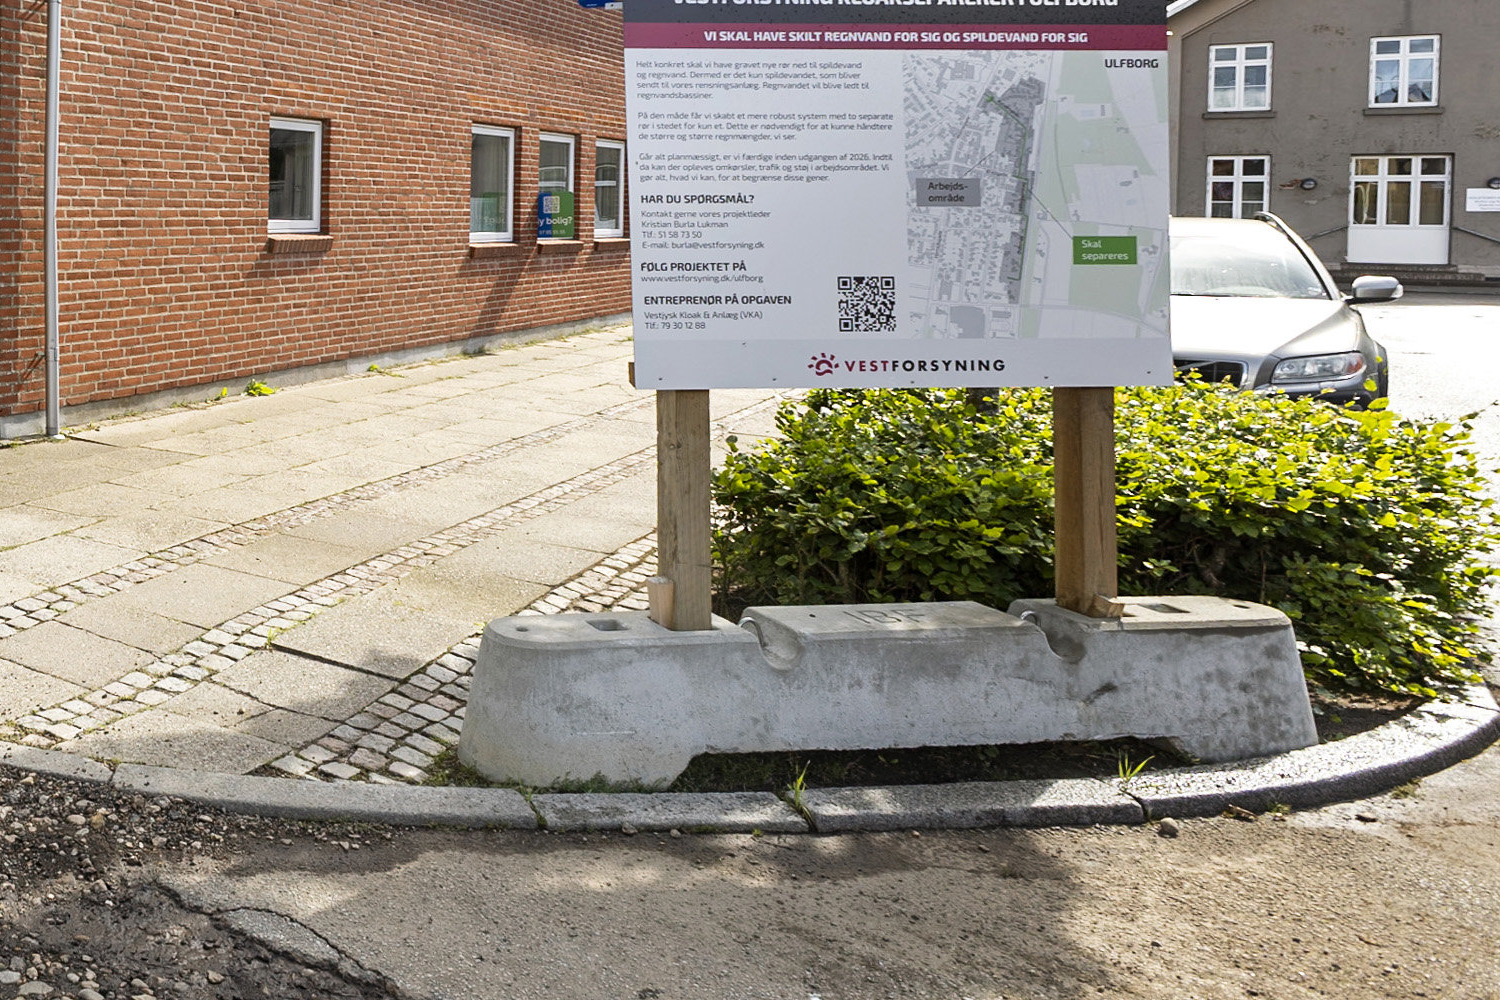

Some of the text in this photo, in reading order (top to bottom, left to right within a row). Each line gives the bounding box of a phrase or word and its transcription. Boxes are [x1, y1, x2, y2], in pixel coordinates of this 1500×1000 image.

[704, 31, 1088, 43] VI SKAL HAVE SKILT REGNVAND FOR SIG OG SPILDEVAND FOR SIG
[734, 62, 761, 70] gravet
[809, 61, 818, 69] til
[818, 62, 862, 70] spildevand
[1104, 58, 1159, 69] ULFBORG
[636, 72, 647, 80] og
[689, 71, 722, 79] Dermed
[732, 71, 747, 79] det
[762, 81, 810, 91] Regnvandet
[861, 82, 870, 90] til
[713, 112, 735, 120] skabt
[769, 112, 796, 120] robust
[797, 113, 827, 121] system
[858, 113, 894, 121] separate
[684, 122, 695, 130] for
[726, 122, 749, 130] Dette
[760, 123, 805, 131] nødvendigt
[806, 122, 819, 130] for
[856, 122, 893, 131] håndtere
[742, 153, 773, 162] færdige
[798, 154, 838, 162] udgangen
[839, 153, 848, 161] af
[872, 153, 894, 161] Indtil
[682, 164, 714, 172] opleves
[758, 163, 780, 171] trafik
[793, 164, 809, 172] støj
[880, 163, 890, 171] Vi
[640, 175, 653, 183] gør
[718, 174, 731, 182] for
[741, 174, 782, 183] begrænse
[783, 174, 805, 182] disse
[927, 182, 968, 192] Arbejds-
[640, 192, 755, 204] HAR DU SPØRGSMÅL?
[928, 193, 965, 202] område
[722, 210, 771, 219] projektleder
[546, 217, 572, 226] bolig?
[673, 220, 695, 228] Burla
[642, 230, 703, 239] Tlf.: 51 58 73 50
[642, 241, 765, 251] E-mail: burla@vestforsyning.dk
[1081, 239, 1102, 248] Skal
[1081, 253, 1129, 261] separeres
[640, 260, 747, 272] FØLG PROJEKTET PÅ
[641, 274, 764, 284] www.vestforsyning.dk/ulfborg
[644, 293, 792, 305] ENTREPRENØR PÅ OPGAVEN
[644, 312, 678, 320] Vestjysk
[703, 311, 710, 319] &
[712, 311, 739, 321] Anlæg
[740, 311, 763, 320] (VKA)
[661, 322, 671, 330] 79
[673, 321, 683, 330] 30
[684, 321, 693, 330] 12
[694, 321, 706, 330] 88
[844, 359, 1005, 372] VESTFORSYNING
[842, 608, 925, 624] IBF
